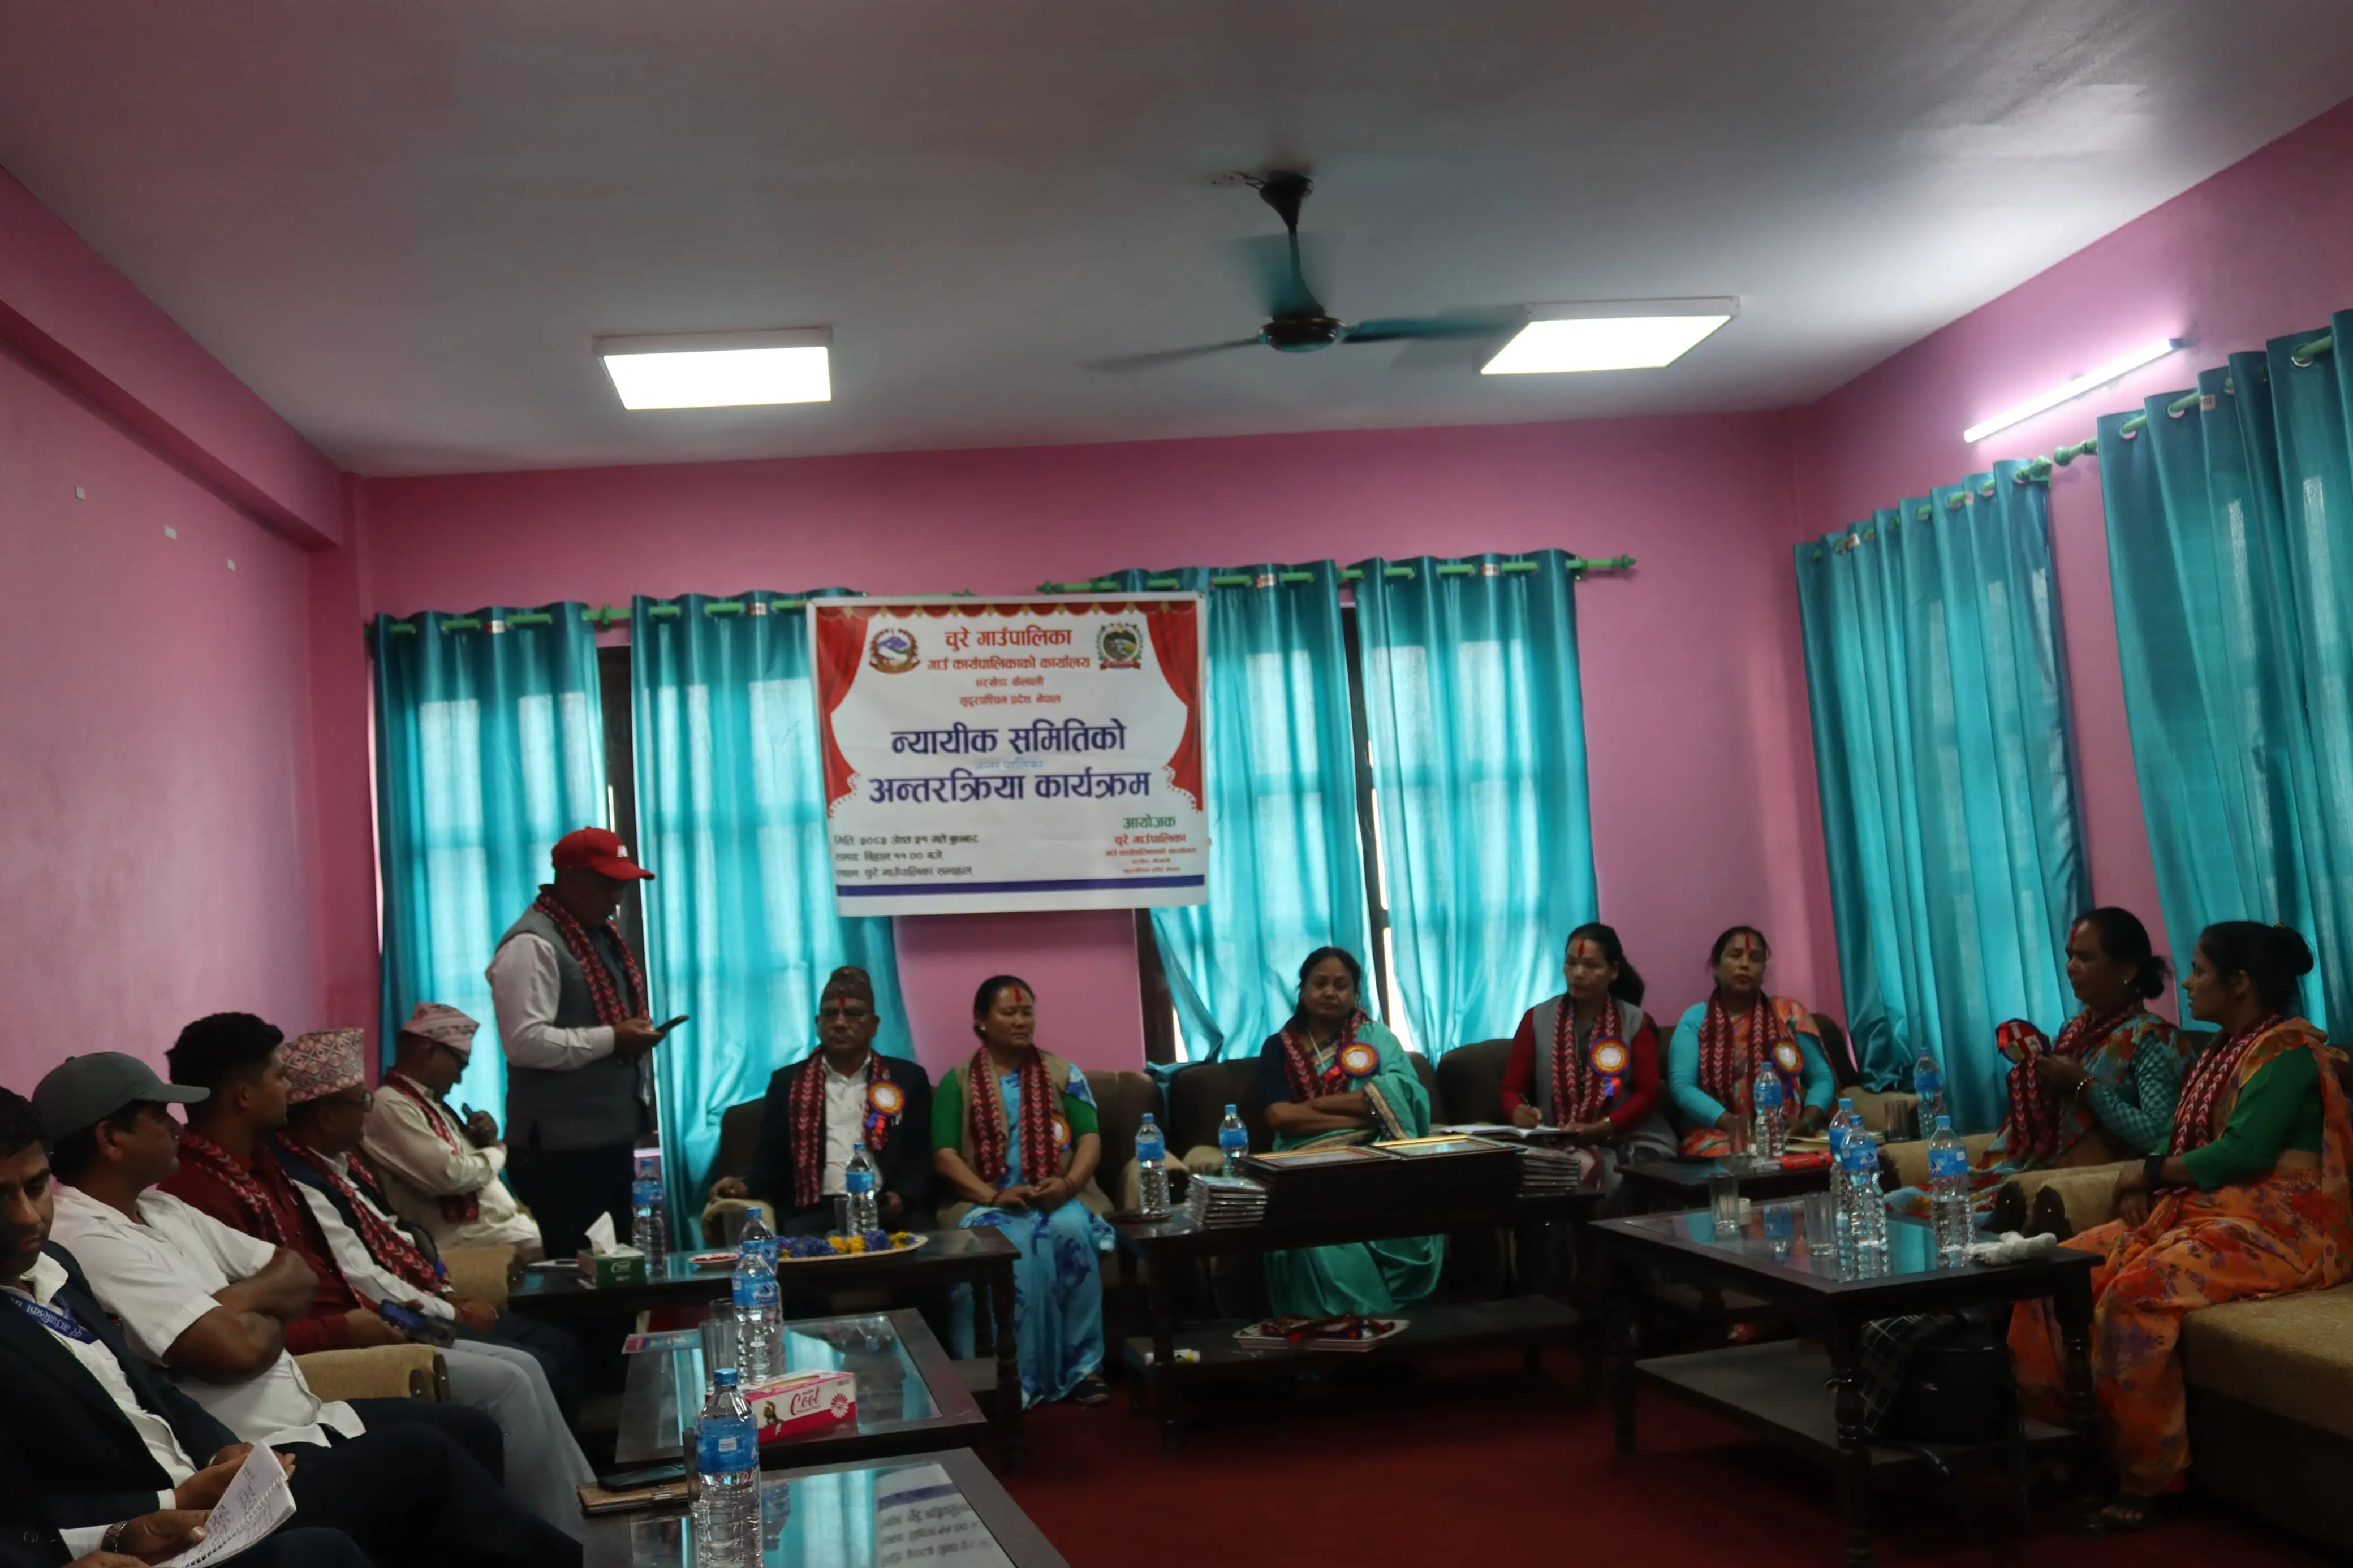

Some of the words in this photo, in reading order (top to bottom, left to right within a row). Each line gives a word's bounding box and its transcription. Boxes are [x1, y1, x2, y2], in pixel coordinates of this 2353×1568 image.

[945, 627, 970, 651] चुरे
[1040, 655, 1091, 669] कार्यालय
[1036, 693, 1062, 704] नेपाल
[891, 722, 999, 755] न्यायीक
[1008, 718, 1127, 754] समितिको
[868, 767, 1025, 804] अन्तरक्रिया
[1035, 767, 1152, 800] कार्यक्रम
[1123, 814, 1176, 829] आयोजक
[790, 1384, 820, 1415] Cool
